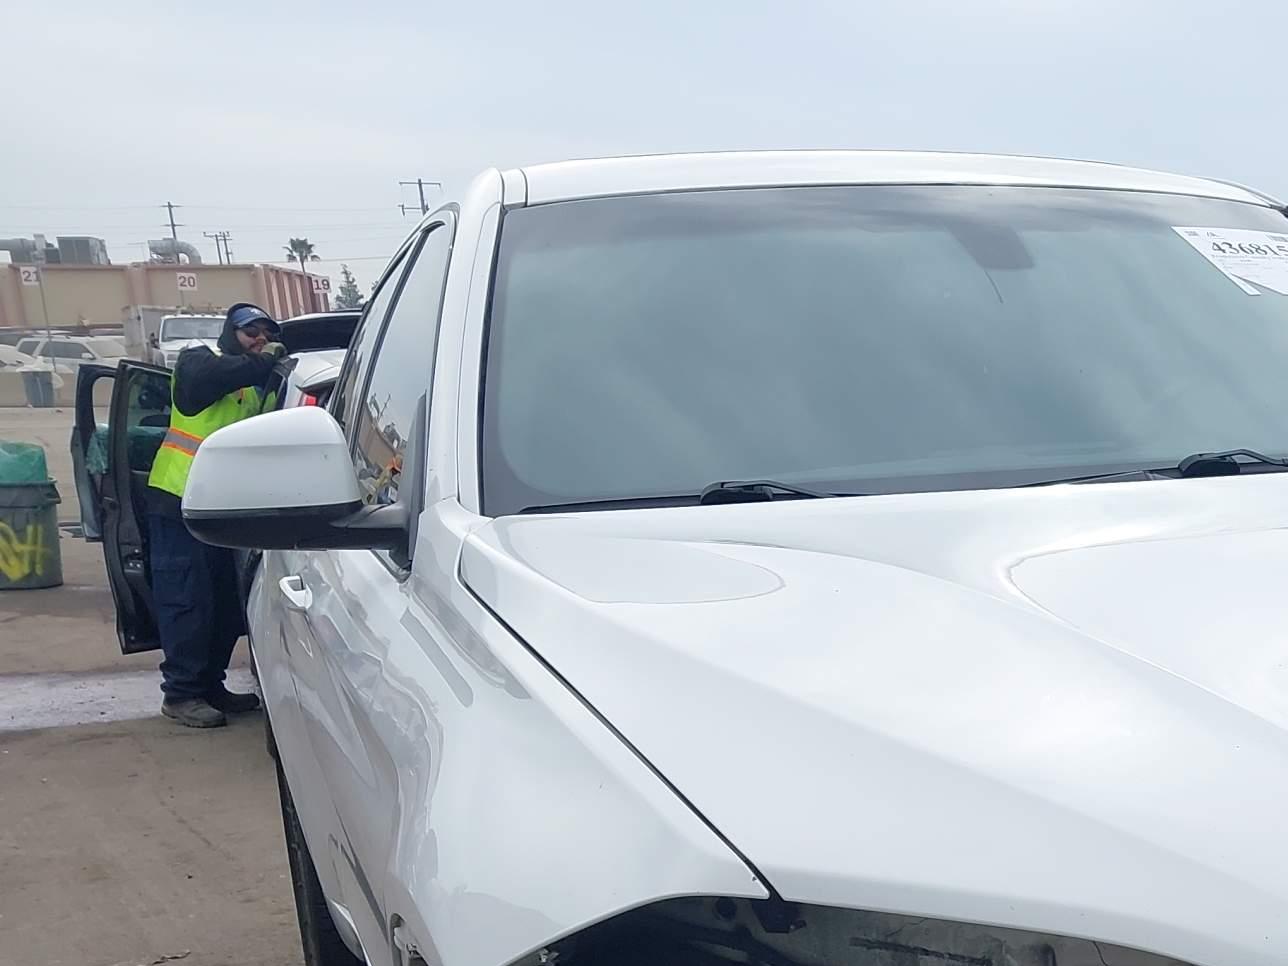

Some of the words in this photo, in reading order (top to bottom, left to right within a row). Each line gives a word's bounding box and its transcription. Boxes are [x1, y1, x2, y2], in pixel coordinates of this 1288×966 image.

[22, 270, 41, 282] 21
[178, 275, 196, 288] 20
[314, 278, 331, 291] 19
